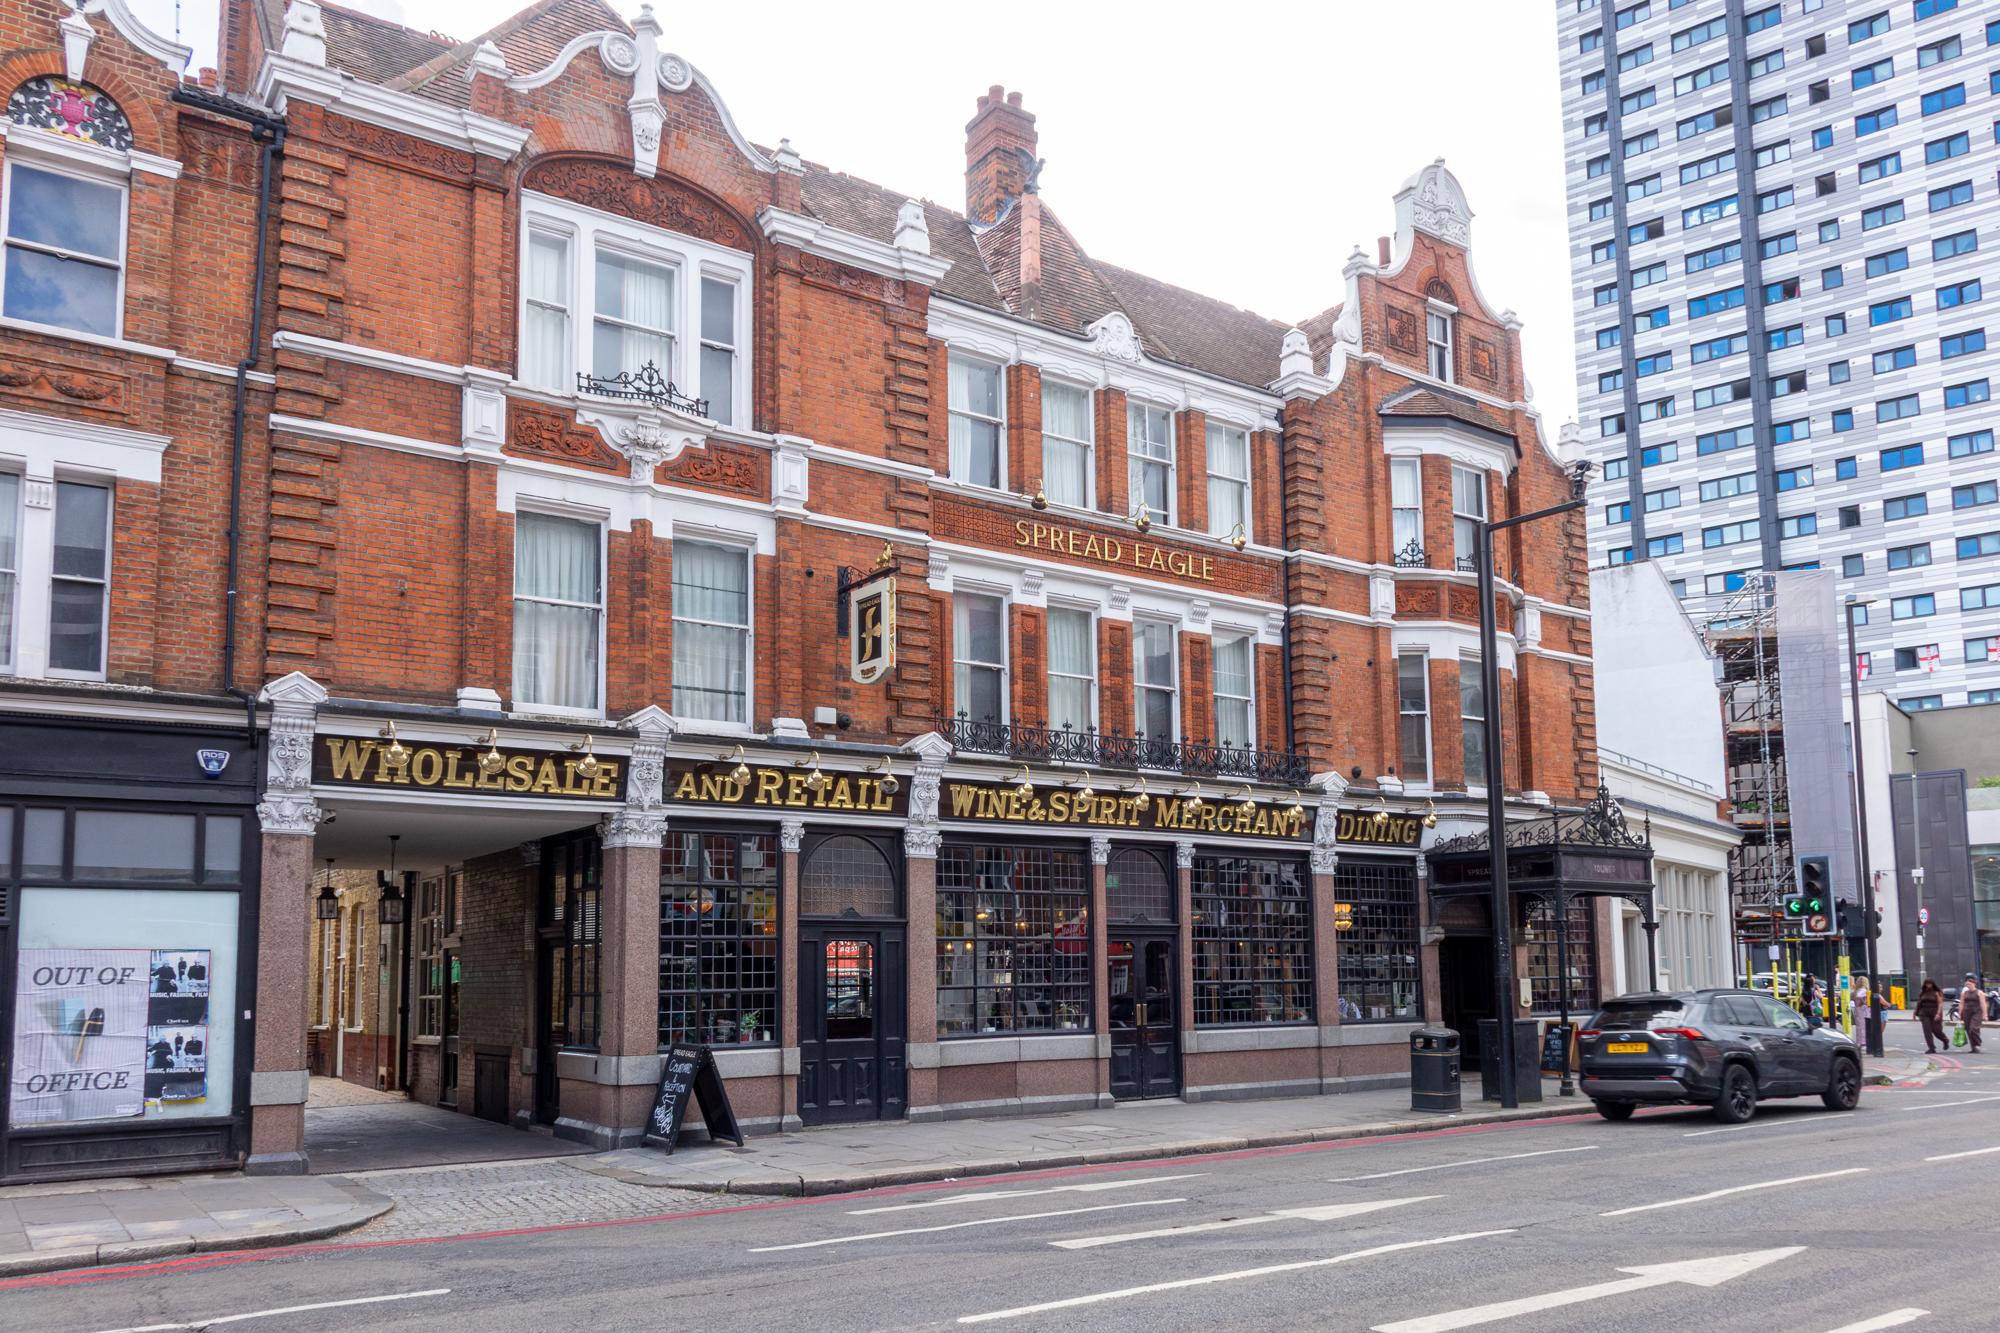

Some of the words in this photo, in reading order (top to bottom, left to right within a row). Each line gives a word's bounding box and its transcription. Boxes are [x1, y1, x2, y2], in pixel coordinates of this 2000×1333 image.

[1015, 519, 1121, 562] SPREAD
[1134, 543, 1214, 581] EAGLE
[326, 738, 619, 797] WHOLESALE
[674, 772, 745, 802] AND
[754, 768, 893, 811] RETAIL
[1154, 797, 1304, 837] MERCHANT
[1337, 813, 1417, 844] DINING
[1467, 866, 1492, 877] SPREA
[33, 967, 93, 986] OUT
[97, 967, 136, 985] OF
[26, 1071, 130, 1093] OFFICE
